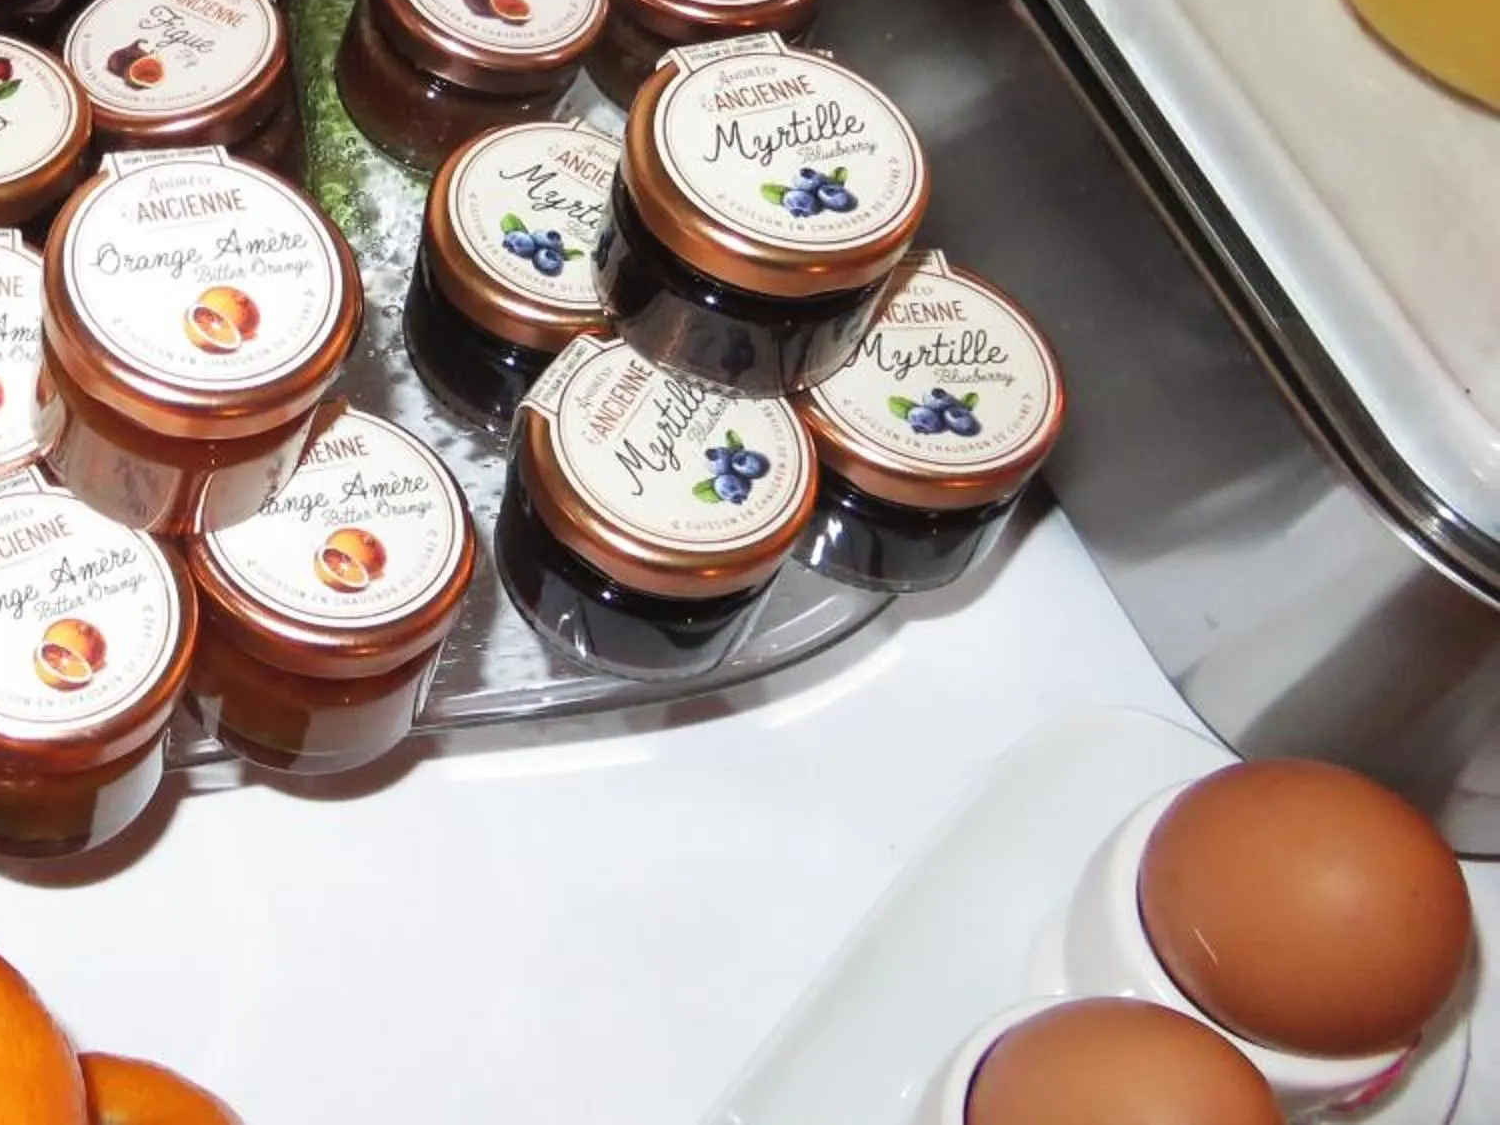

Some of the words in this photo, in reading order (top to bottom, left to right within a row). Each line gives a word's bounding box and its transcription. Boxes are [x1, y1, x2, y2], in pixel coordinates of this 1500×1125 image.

[138, 3, 216, 55] Figue
[713, 74, 817, 113] ANCIENNE
[702, 100, 866, 167] Myrtille
[796, 138, 879, 164] Blueberry
[554, 149, 615, 190] ANCIE
[136, 188, 248, 224] ANCIENNE
[500, 162, 604, 230] Myrti
[89, 242, 202, 279] Orange
[214, 227, 308, 260] Amère
[251, 257, 314, 277] Orange
[880, 300, 969, 325] NCIENNE
[845, 328, 1010, 380] Myrtille
[933, 366, 1015, 388] Blueberry
[589, 359, 656, 440] ANCIENNE
[340, 470, 430, 501] Amère
[50, 545, 138, 593] Amère
[86, 572, 148, 601] Orange
